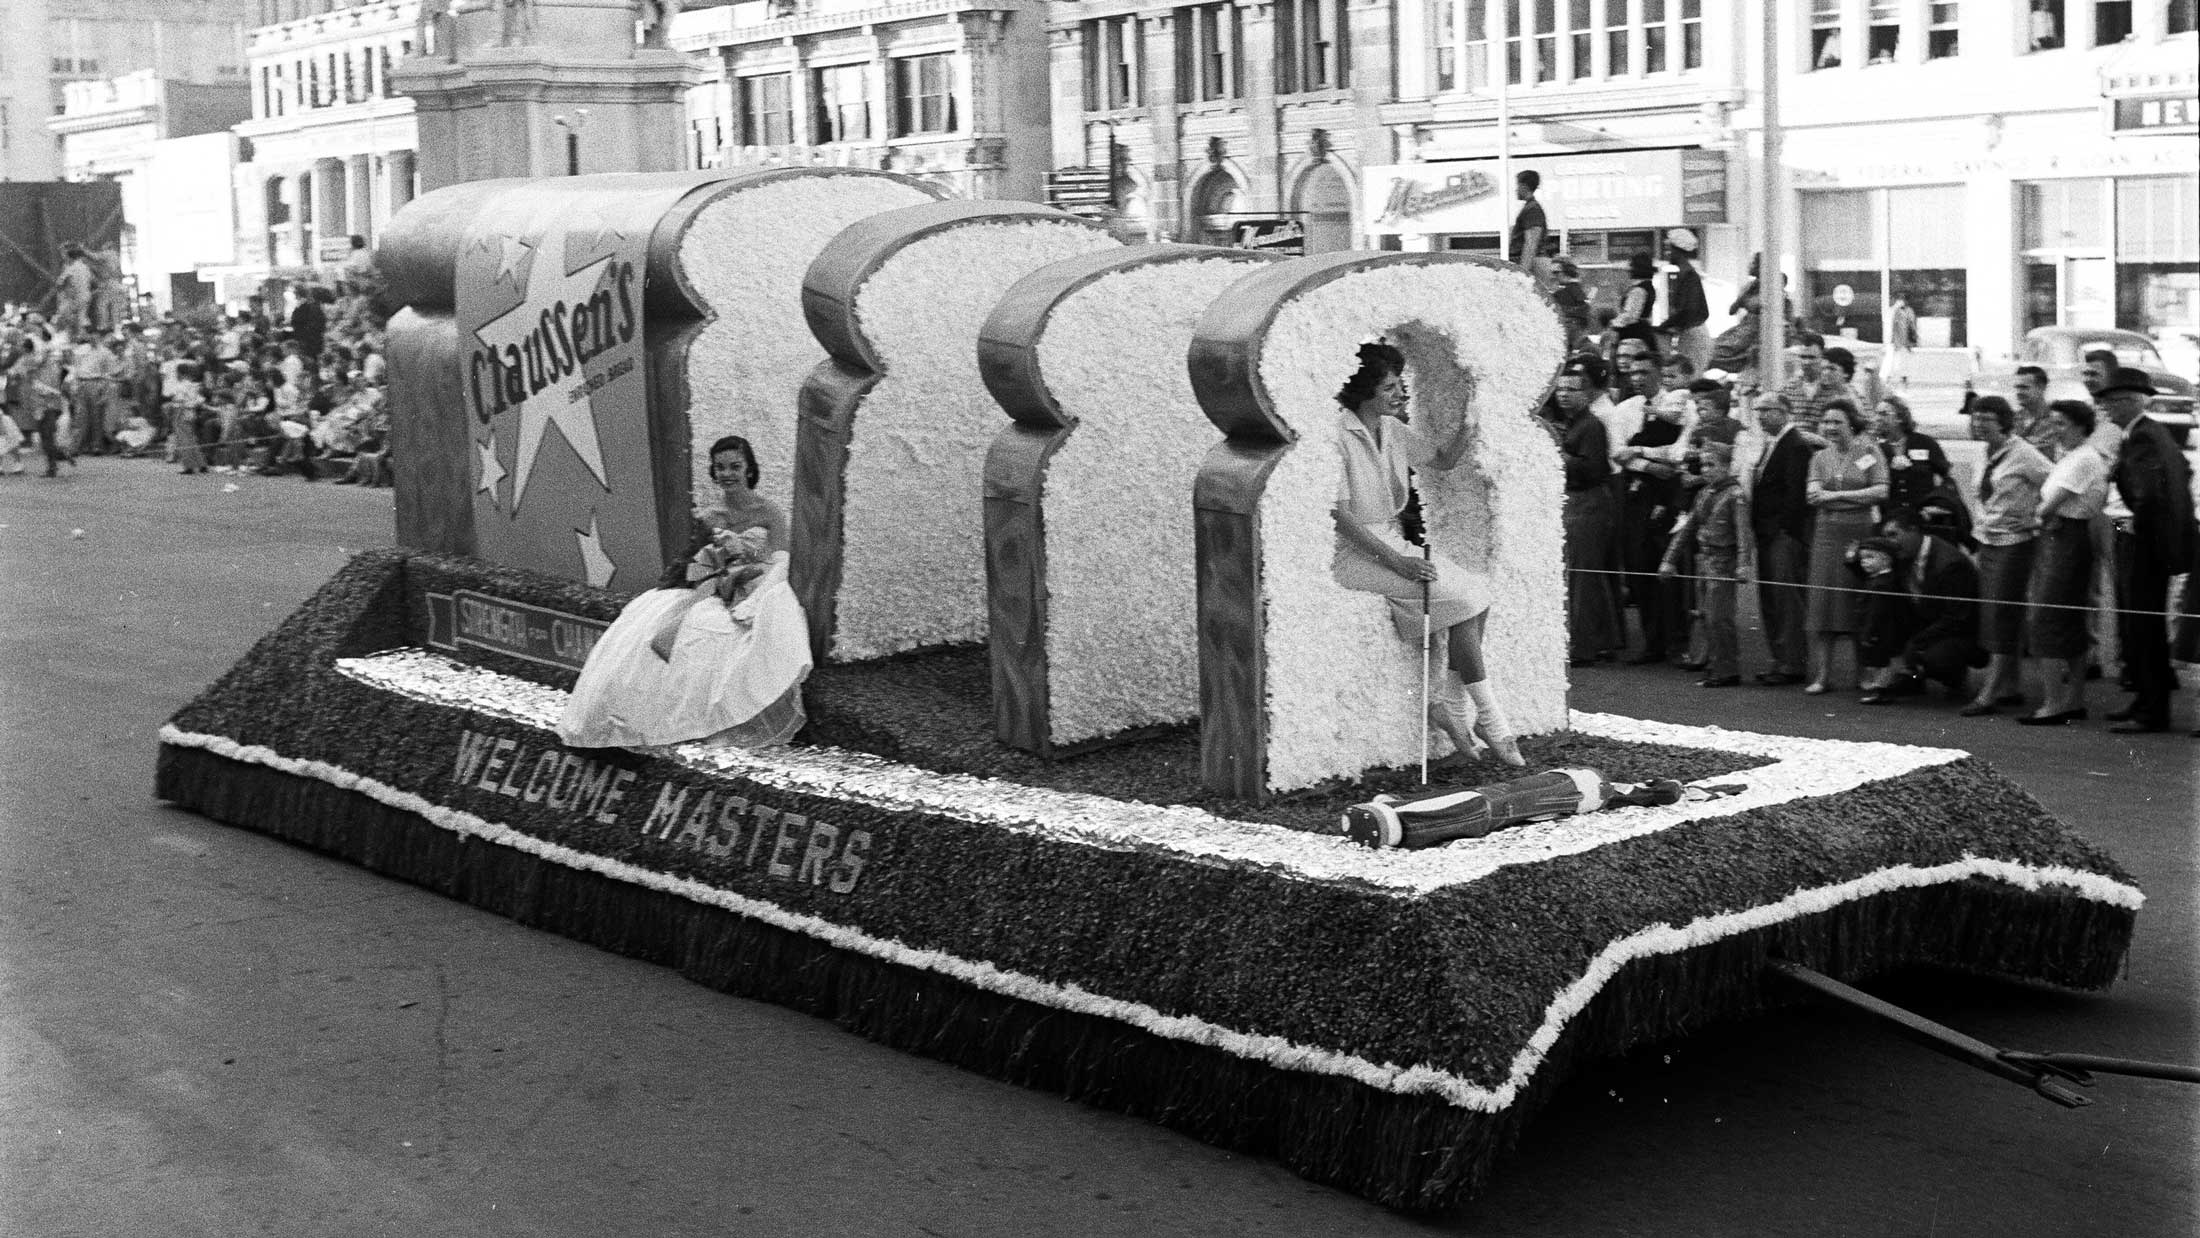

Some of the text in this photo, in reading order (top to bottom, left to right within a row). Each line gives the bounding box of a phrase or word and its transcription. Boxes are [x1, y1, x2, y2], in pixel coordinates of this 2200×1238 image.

[1535, 174, 1664, 200] PORTING
[471, 261, 635, 425] Claussen's
[453, 729, 872, 895] WELCOME MASTERS
